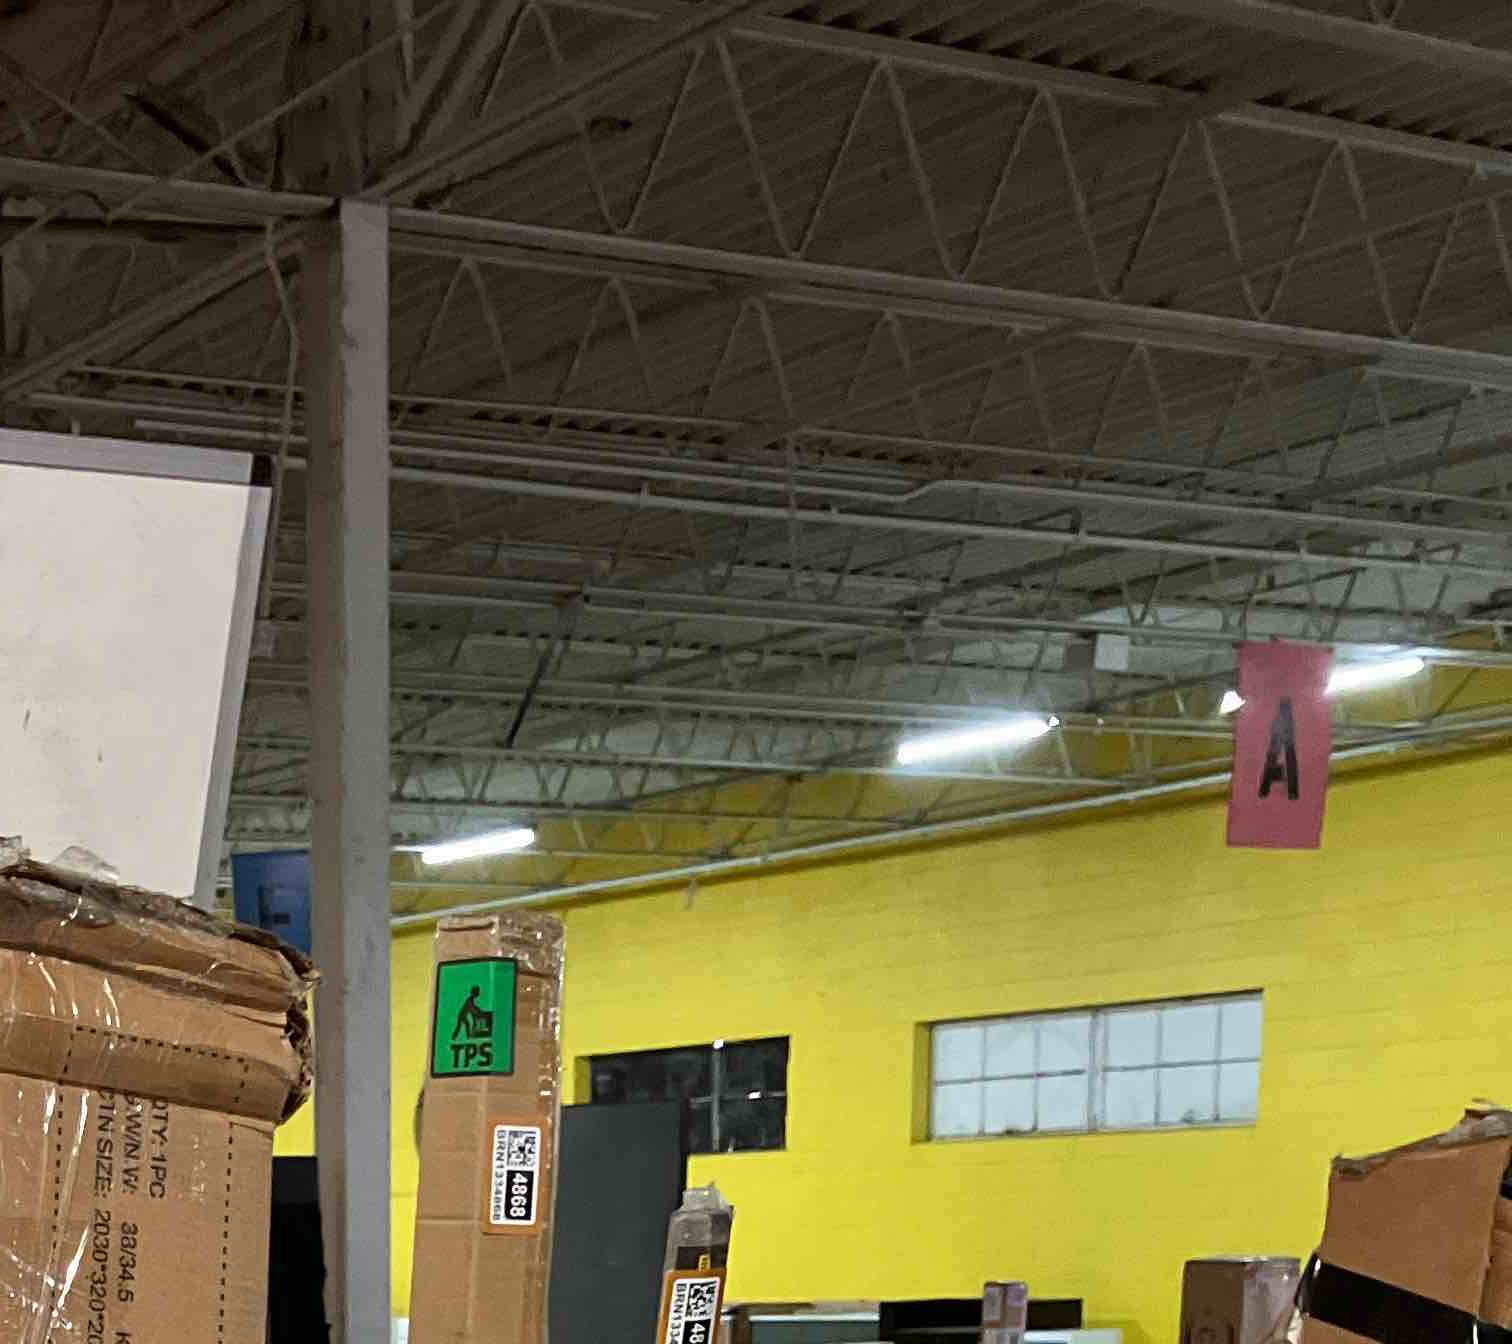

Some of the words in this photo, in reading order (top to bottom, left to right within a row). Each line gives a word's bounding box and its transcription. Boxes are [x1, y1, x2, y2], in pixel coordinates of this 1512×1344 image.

[1257, 696, 1299, 800] A
[450, 1042, 494, 1069] TPS
[94, 1138, 114, 1198] SIZE:
[509, 1172, 528, 1218] 4868
[117, 1221, 139, 1303] 38/34.5
